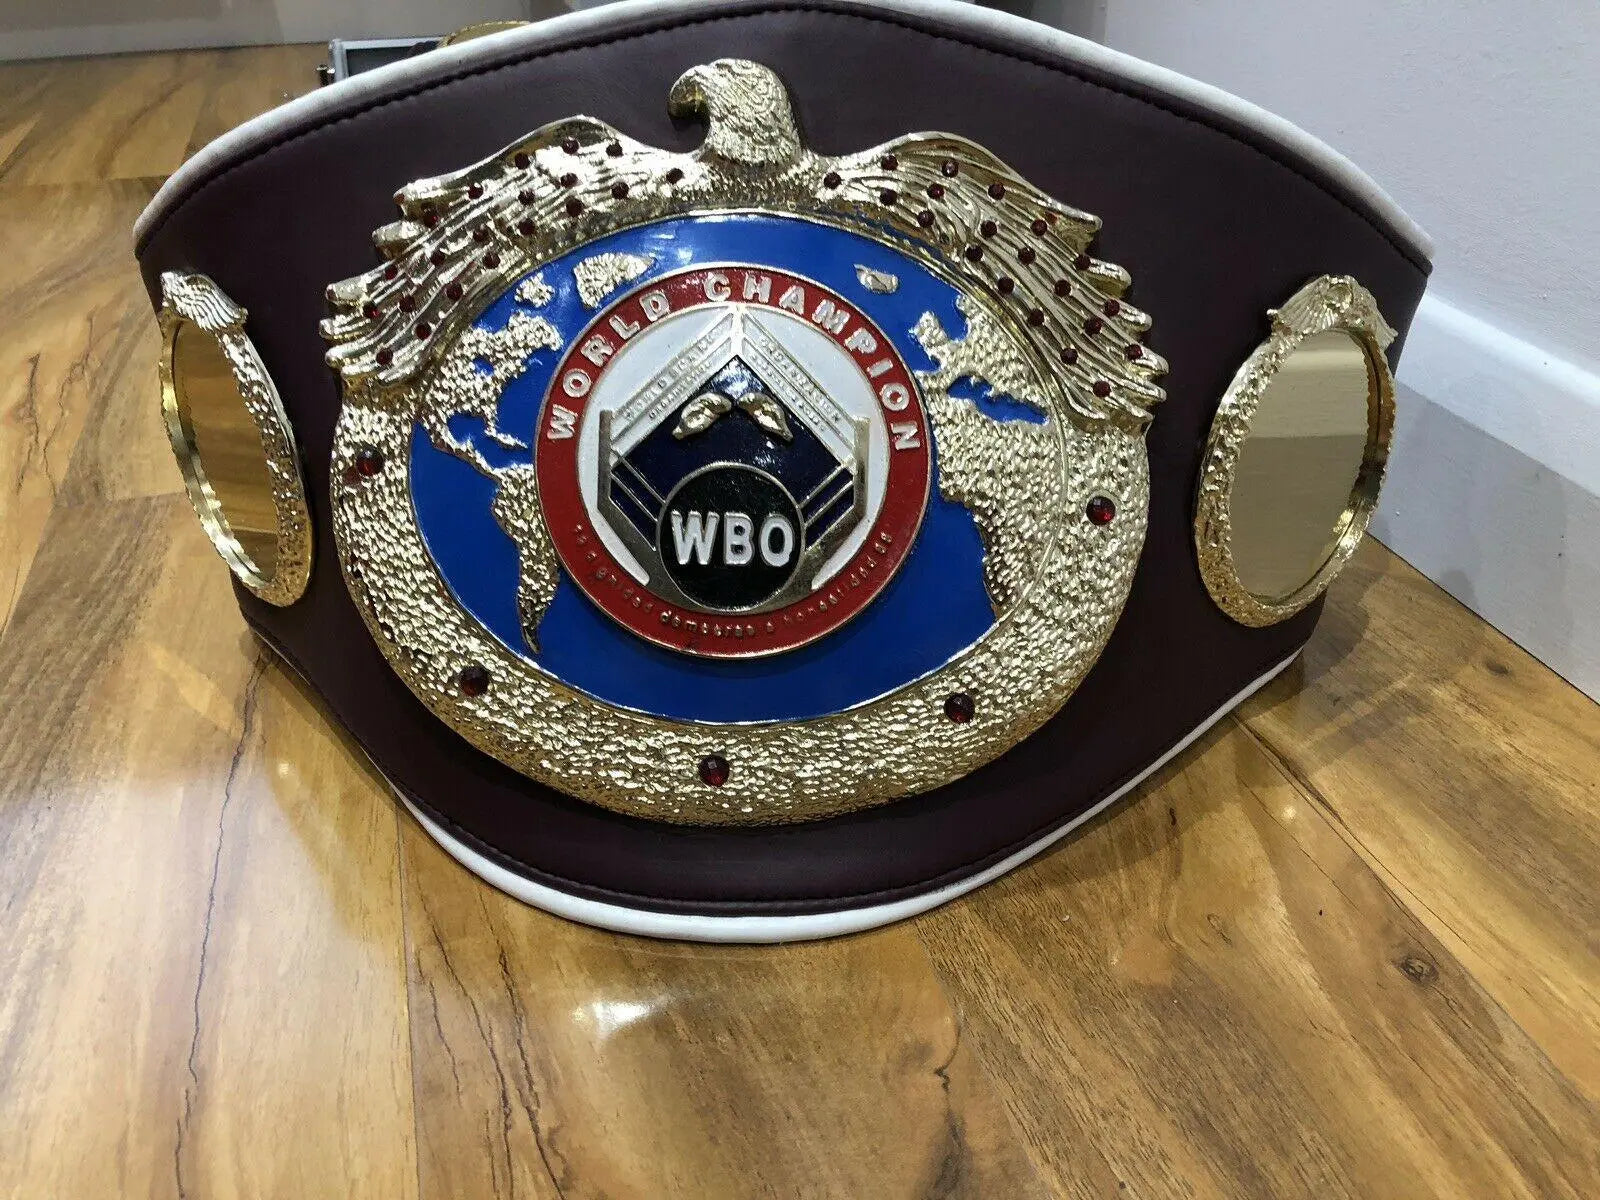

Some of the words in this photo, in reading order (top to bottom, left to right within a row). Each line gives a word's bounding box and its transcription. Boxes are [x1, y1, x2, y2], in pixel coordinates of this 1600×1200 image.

[547, 290, 671, 440] WORLD
[702, 272, 921, 451] CHAMPION
[670, 510, 796, 567] WBO
